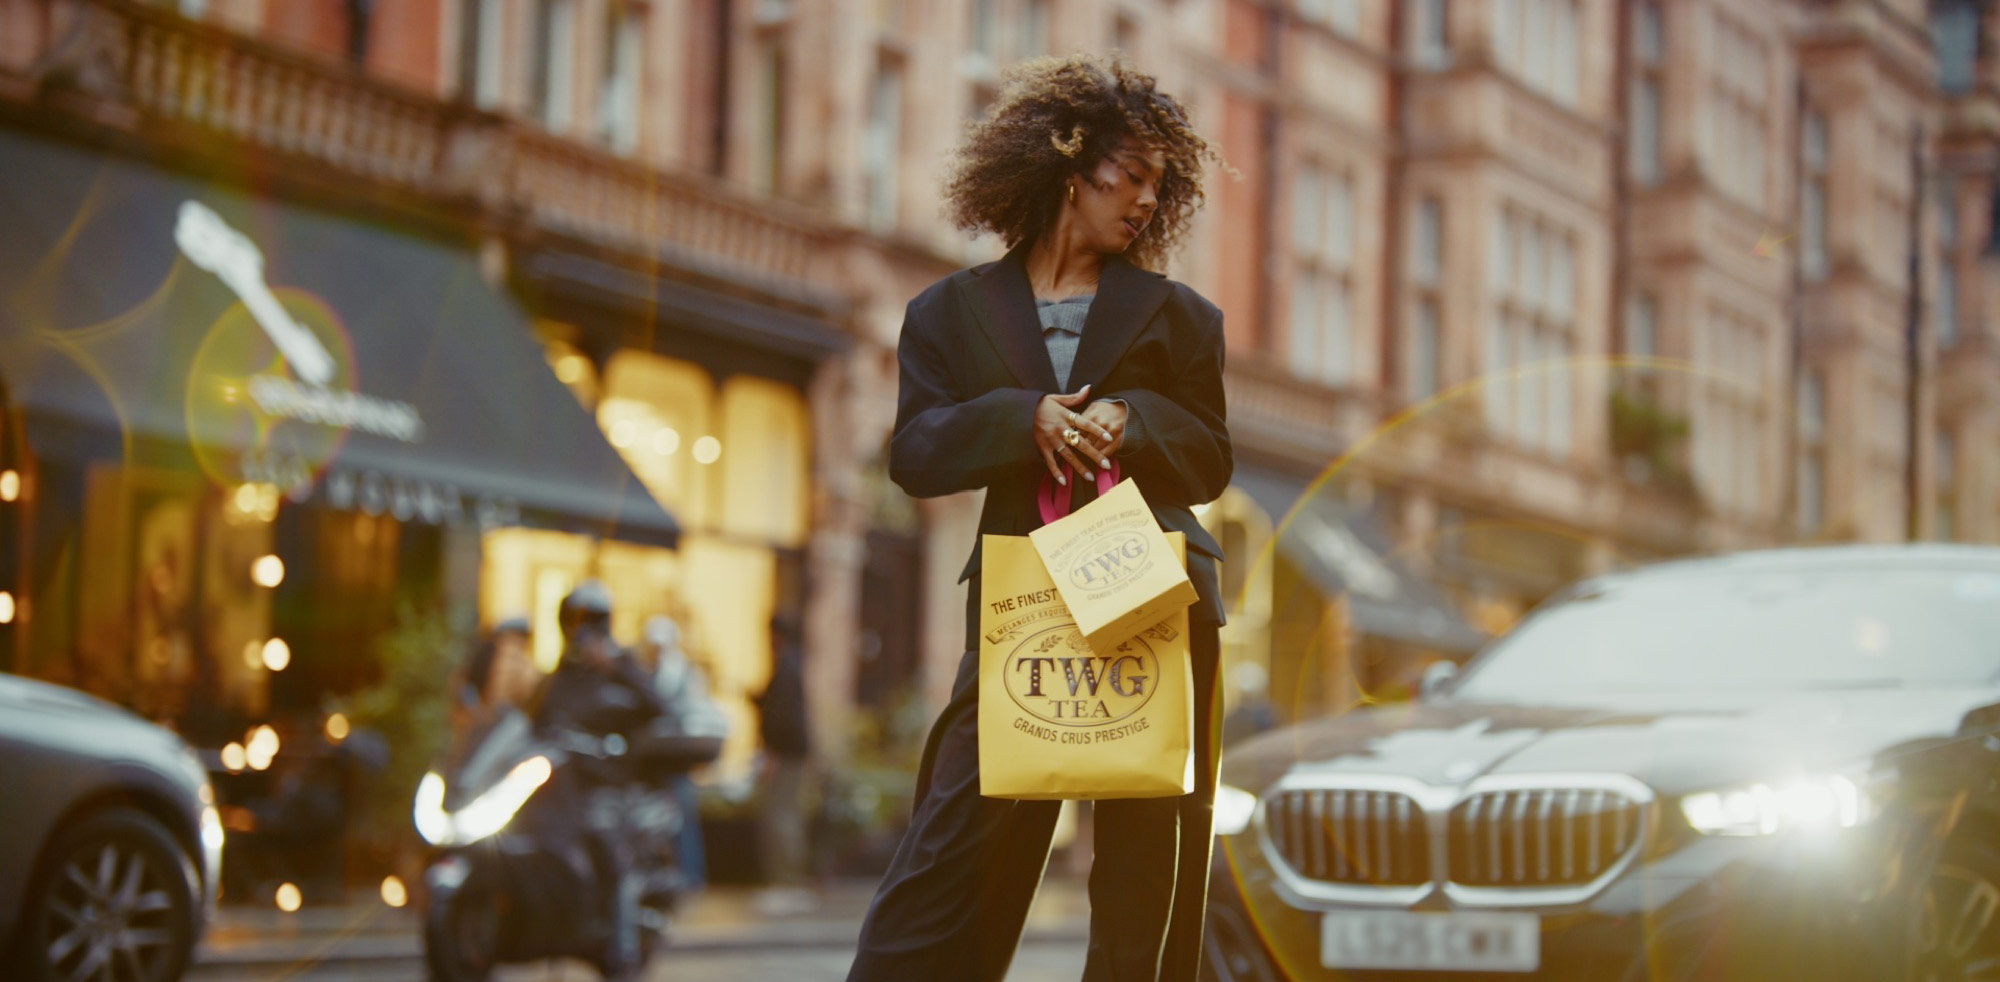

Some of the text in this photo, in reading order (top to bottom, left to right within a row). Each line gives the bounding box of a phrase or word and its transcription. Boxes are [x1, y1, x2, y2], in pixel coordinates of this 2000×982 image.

[1074, 538, 1145, 585] TWG
[1100, 562, 1133, 585] TEA
[990, 588, 1058, 615] THE FINEST
[1016, 656, 1148, 697] TWG
[1048, 700, 1112, 718] TEA
[1014, 717, 1150, 745] GRANDS CRUS PRESTIGE
